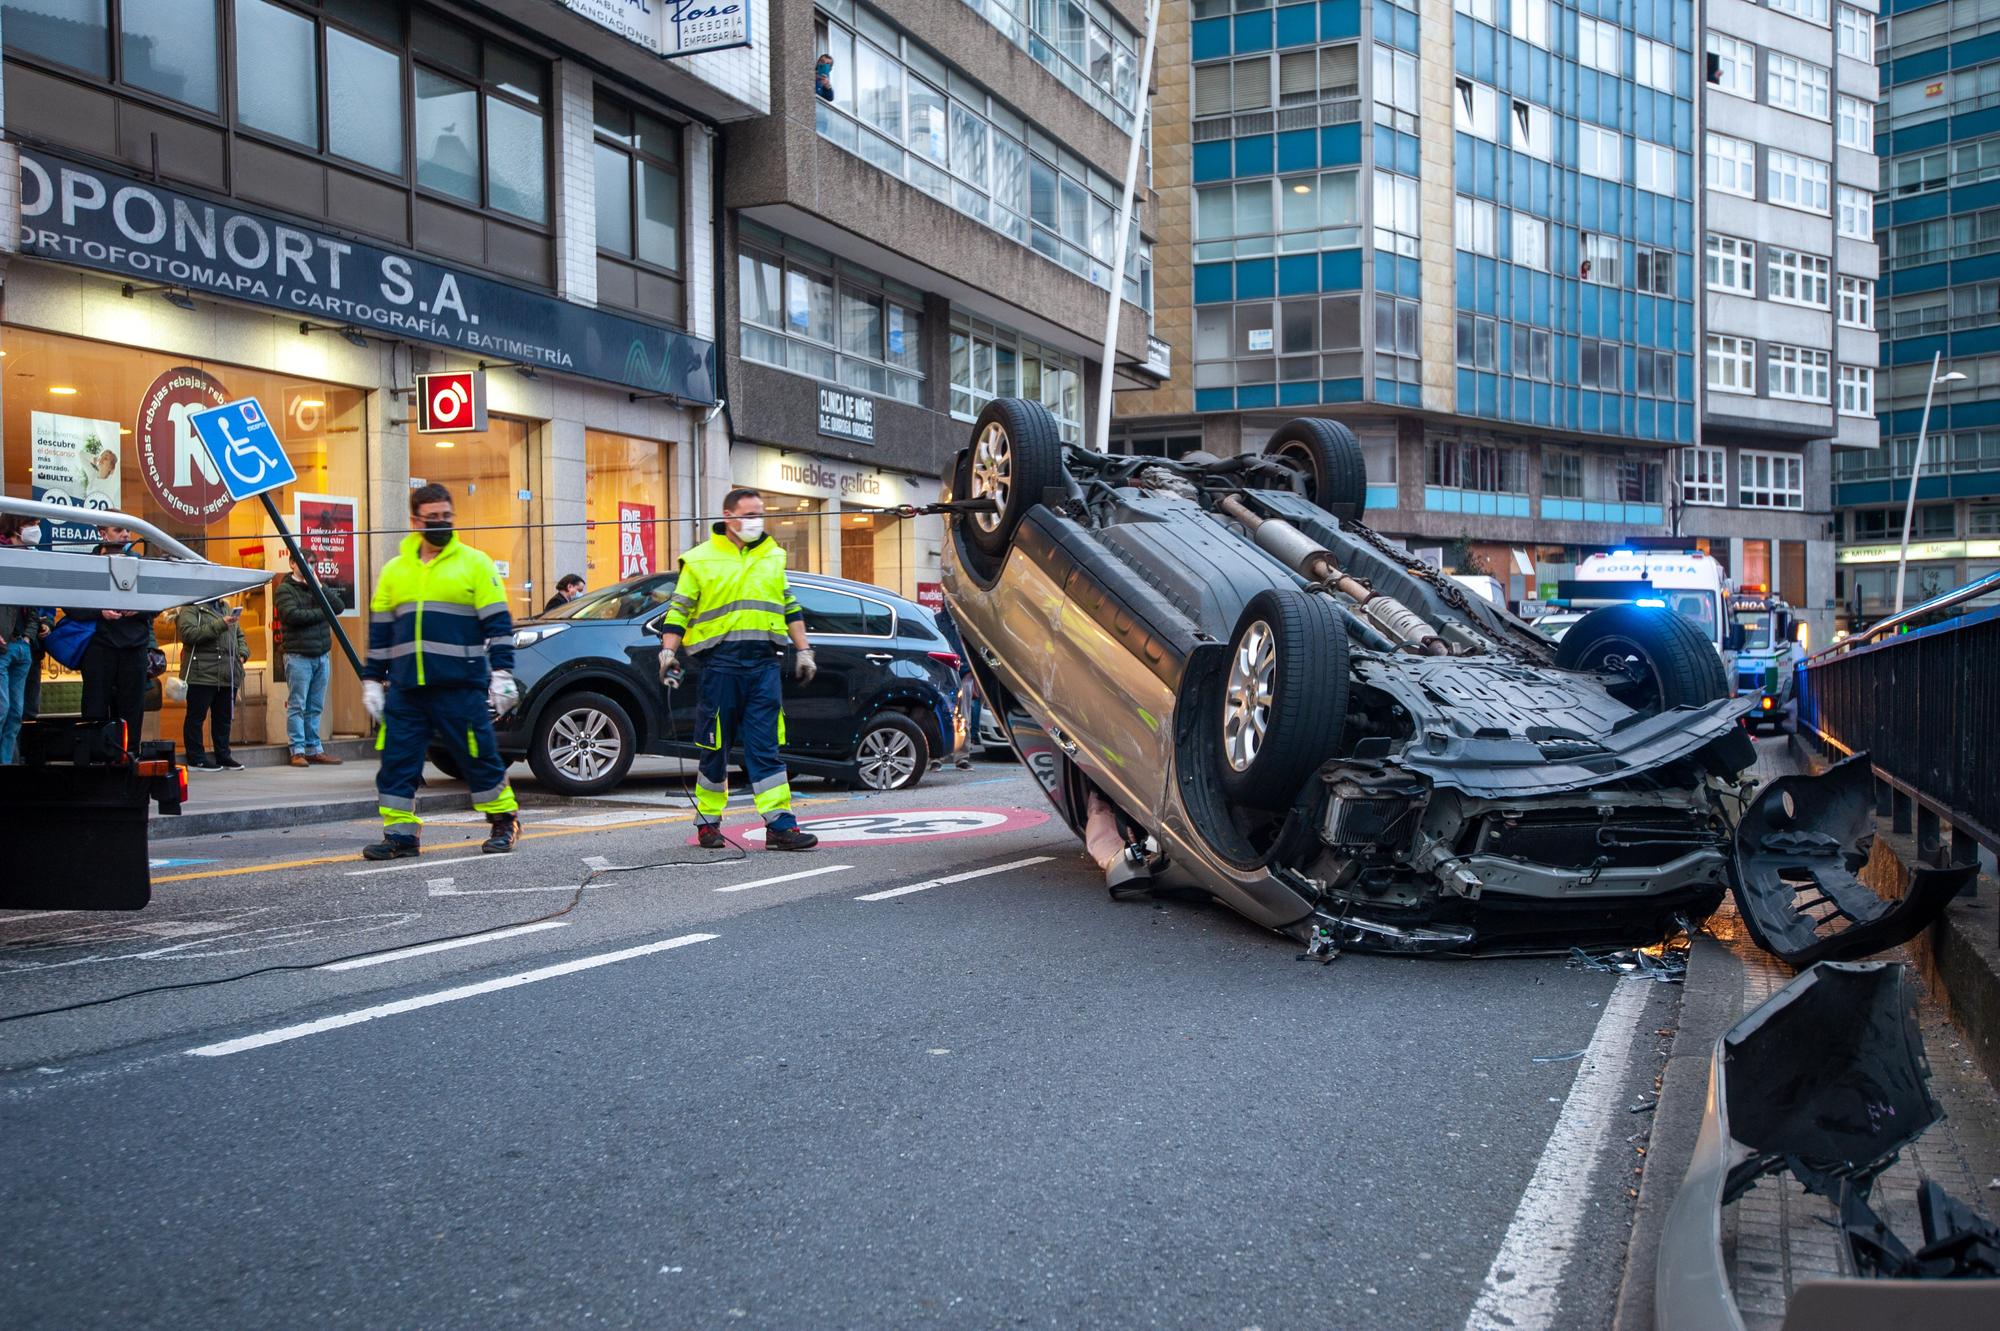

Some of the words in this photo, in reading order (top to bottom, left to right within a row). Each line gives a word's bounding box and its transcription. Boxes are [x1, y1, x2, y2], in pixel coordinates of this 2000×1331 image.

[684, 29, 743, 47] EMPRESARIAL
[20, 225, 269, 298] ORTOFOTOMAPA
[290, 288, 450, 340] CARTOGRAFÍA
[467, 330, 574, 368] BATIMETRÍA
[380, 255, 480, 325] S.A.
[168, 375, 206, 391] rebajas
[208, 386, 228, 405] reb
[145, 385, 168, 431] rebajas
[38, 438, 76, 449] descubre
[144, 434, 163, 488] rebajas
[46, 474, 73, 483] BULTEX
[781, 463, 836, 489] muebles
[840, 472, 880, 496] galicia
[162, 488, 199, 515] rebajas
[621, 532, 645, 557] BA
[318, 562, 339, 575] 55%
